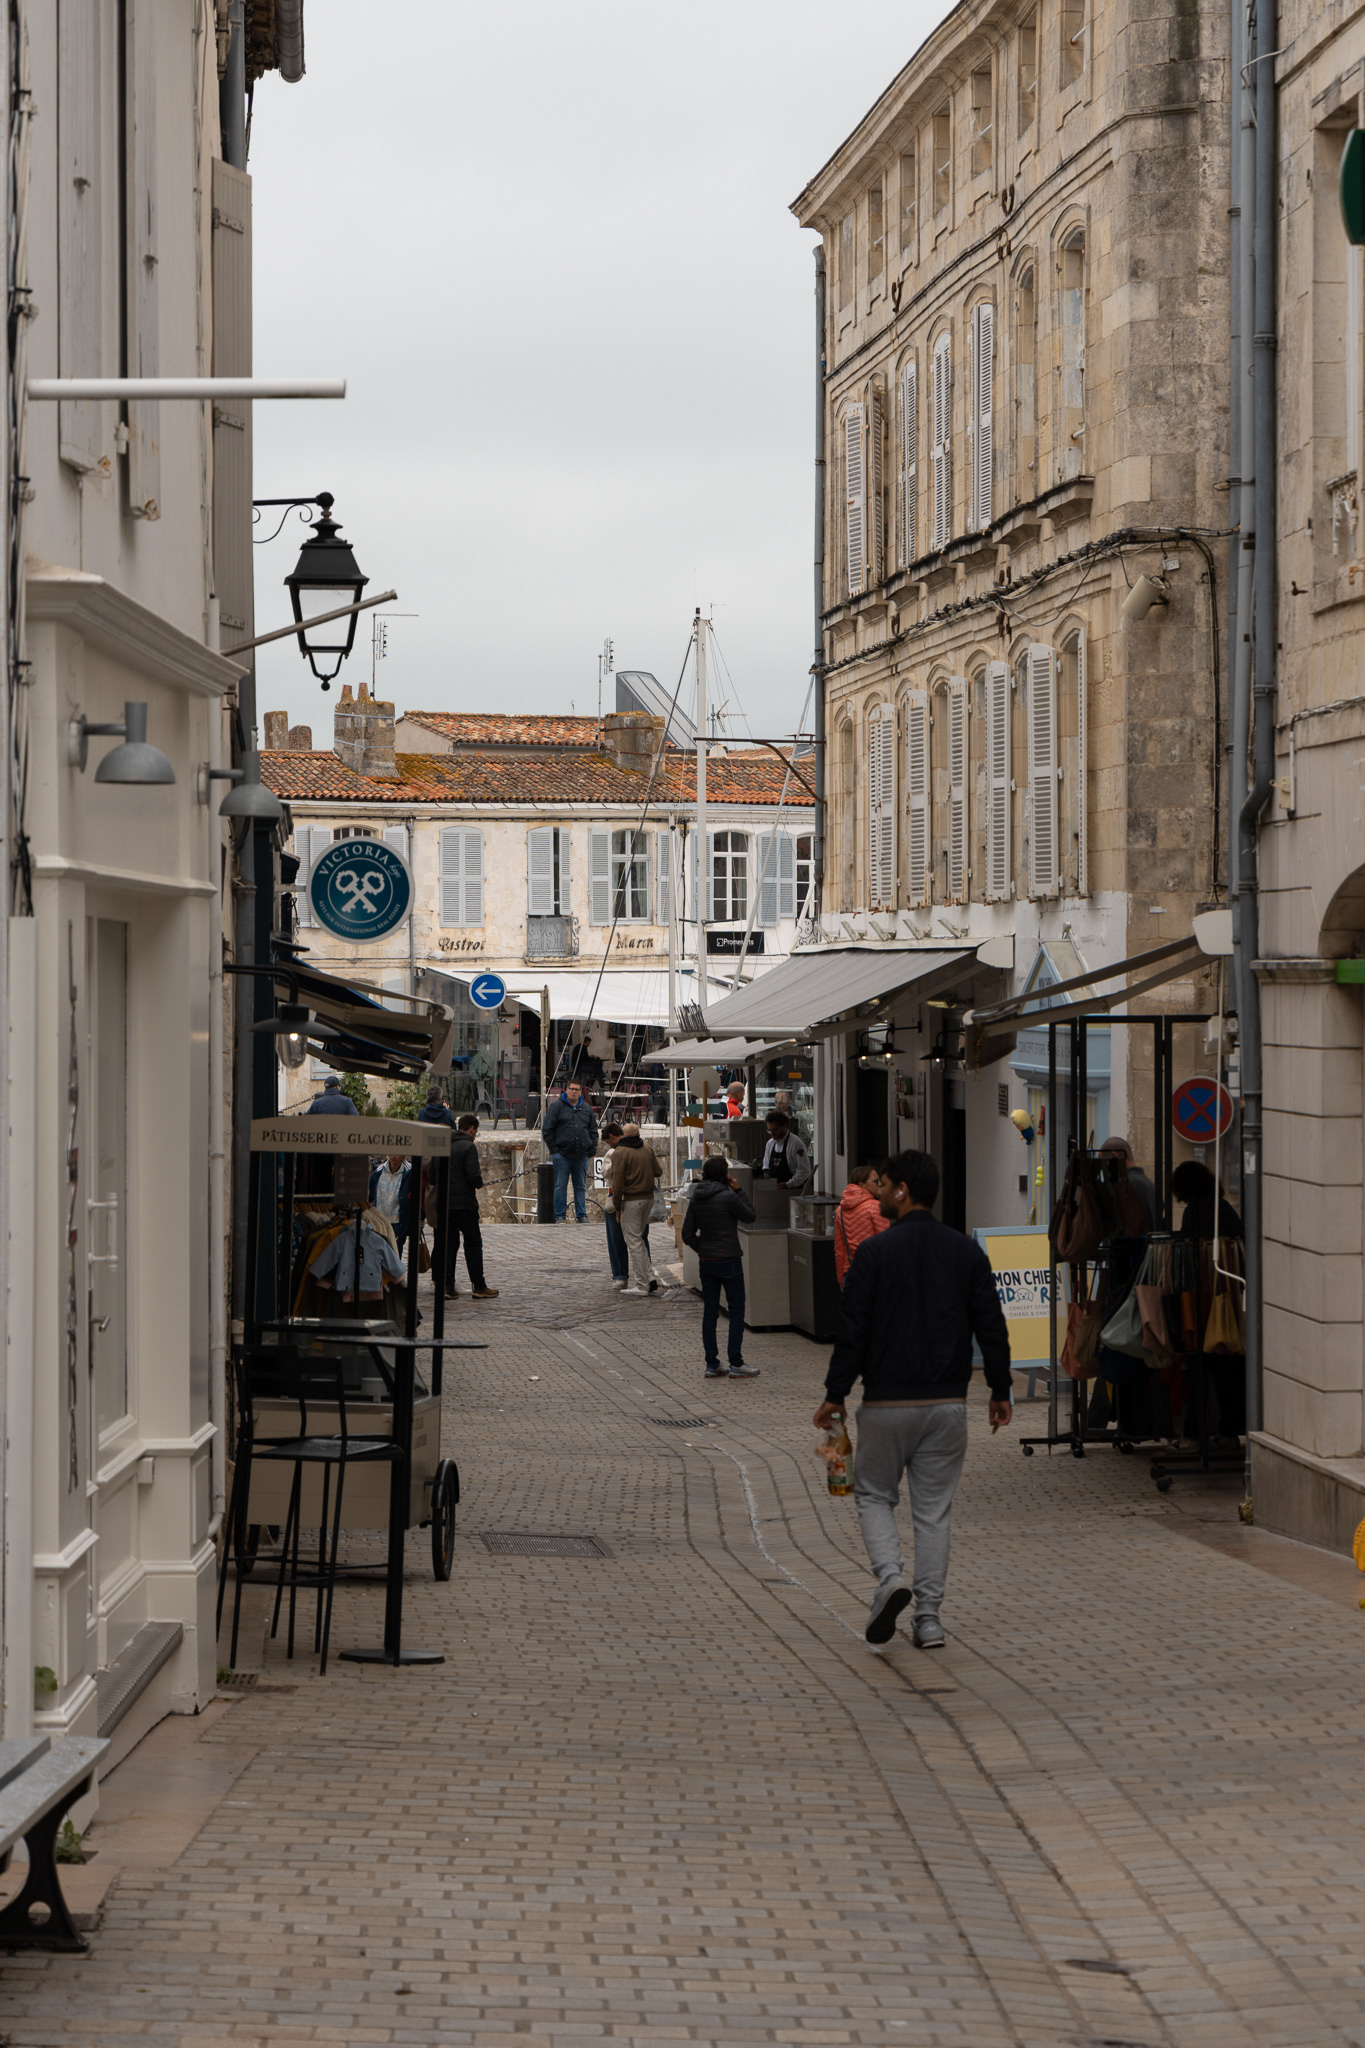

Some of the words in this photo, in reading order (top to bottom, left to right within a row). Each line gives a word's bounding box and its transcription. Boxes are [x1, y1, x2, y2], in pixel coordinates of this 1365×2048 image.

[318, 844, 389, 875] VICTORIA
[333, 920, 378, 934] INTERNATIONAL
[262, 1130, 339, 1145] PÂTISSERIE
[347, 1133, 412, 1147] GLACIÈRE
[991, 1271, 1022, 1288] MON
[1023, 1269, 1062, 1286] CHIEN
[1008, 1304, 1033, 1312] CONCEPT
